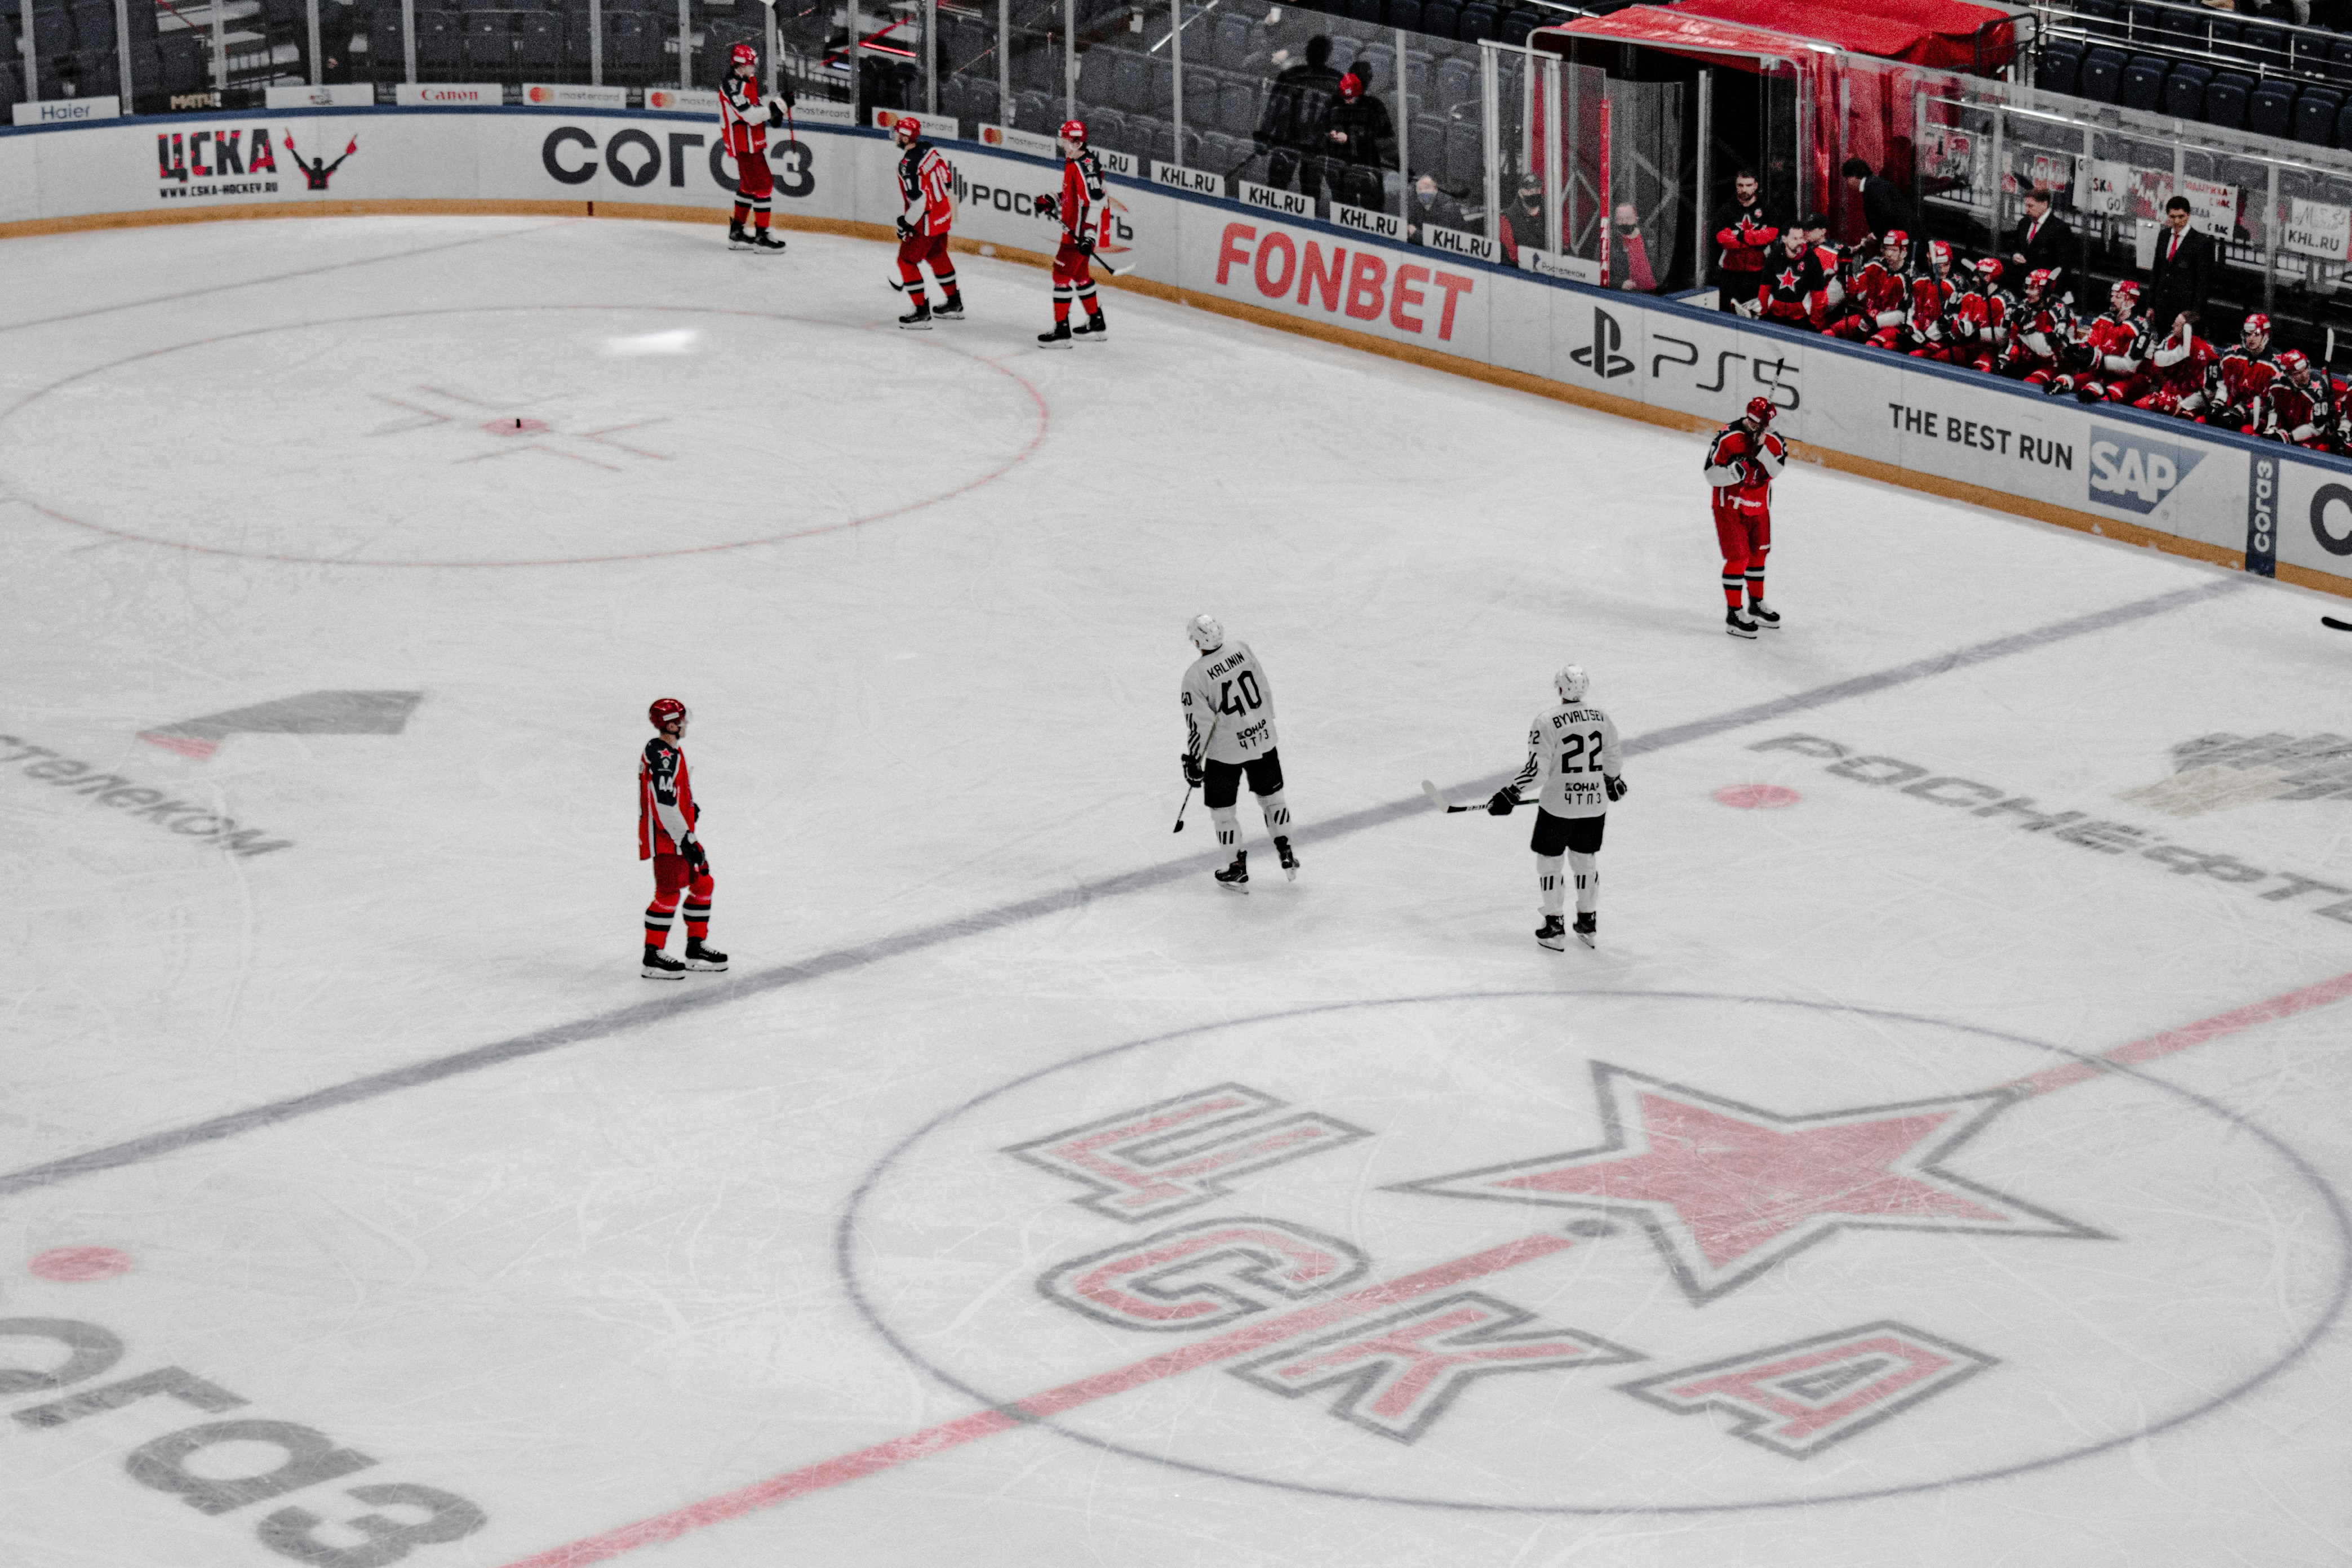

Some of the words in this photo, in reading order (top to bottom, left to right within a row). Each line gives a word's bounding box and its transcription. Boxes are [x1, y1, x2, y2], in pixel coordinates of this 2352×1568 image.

[421, 89, 478, 101] Canon
[560, 92, 619, 101] mastercard
[681, 97, 720, 107] masterc
[41, 103, 90, 120] Haier
[796, 106, 850, 118] mastercard
[922, 120, 952, 132] tercard
[158, 128, 277, 183] ЦСКА
[1008, 135, 1051, 152] mastercard
[160, 182, 278, 198] WWW.CSKA-HOCKEY.RU
[1160, 166, 1215, 193] KHL.RU
[1249, 186, 1306, 215] KHL.RU
[1340, 207, 1397, 237] KHL.RU
[1433, 229, 1492, 258] KHL.RU
[2288, 229, 2340, 252] KHL.RU
[1215, 222, 1474, 341] FONBET
[1541, 261, 1586, 278] Ростелеком
[1653, 334, 1800, 411] PS5
[1889, 402, 1937, 438] THE
[1947, 417, 2011, 454] BEST
[2019, 434, 2073, 470] RUN
[2089, 441, 2177, 503] SAP
[1206, 651, 1245, 680] KALININ
[1219, 670, 1262, 717] 40
[1561, 730, 1603, 774] 22
